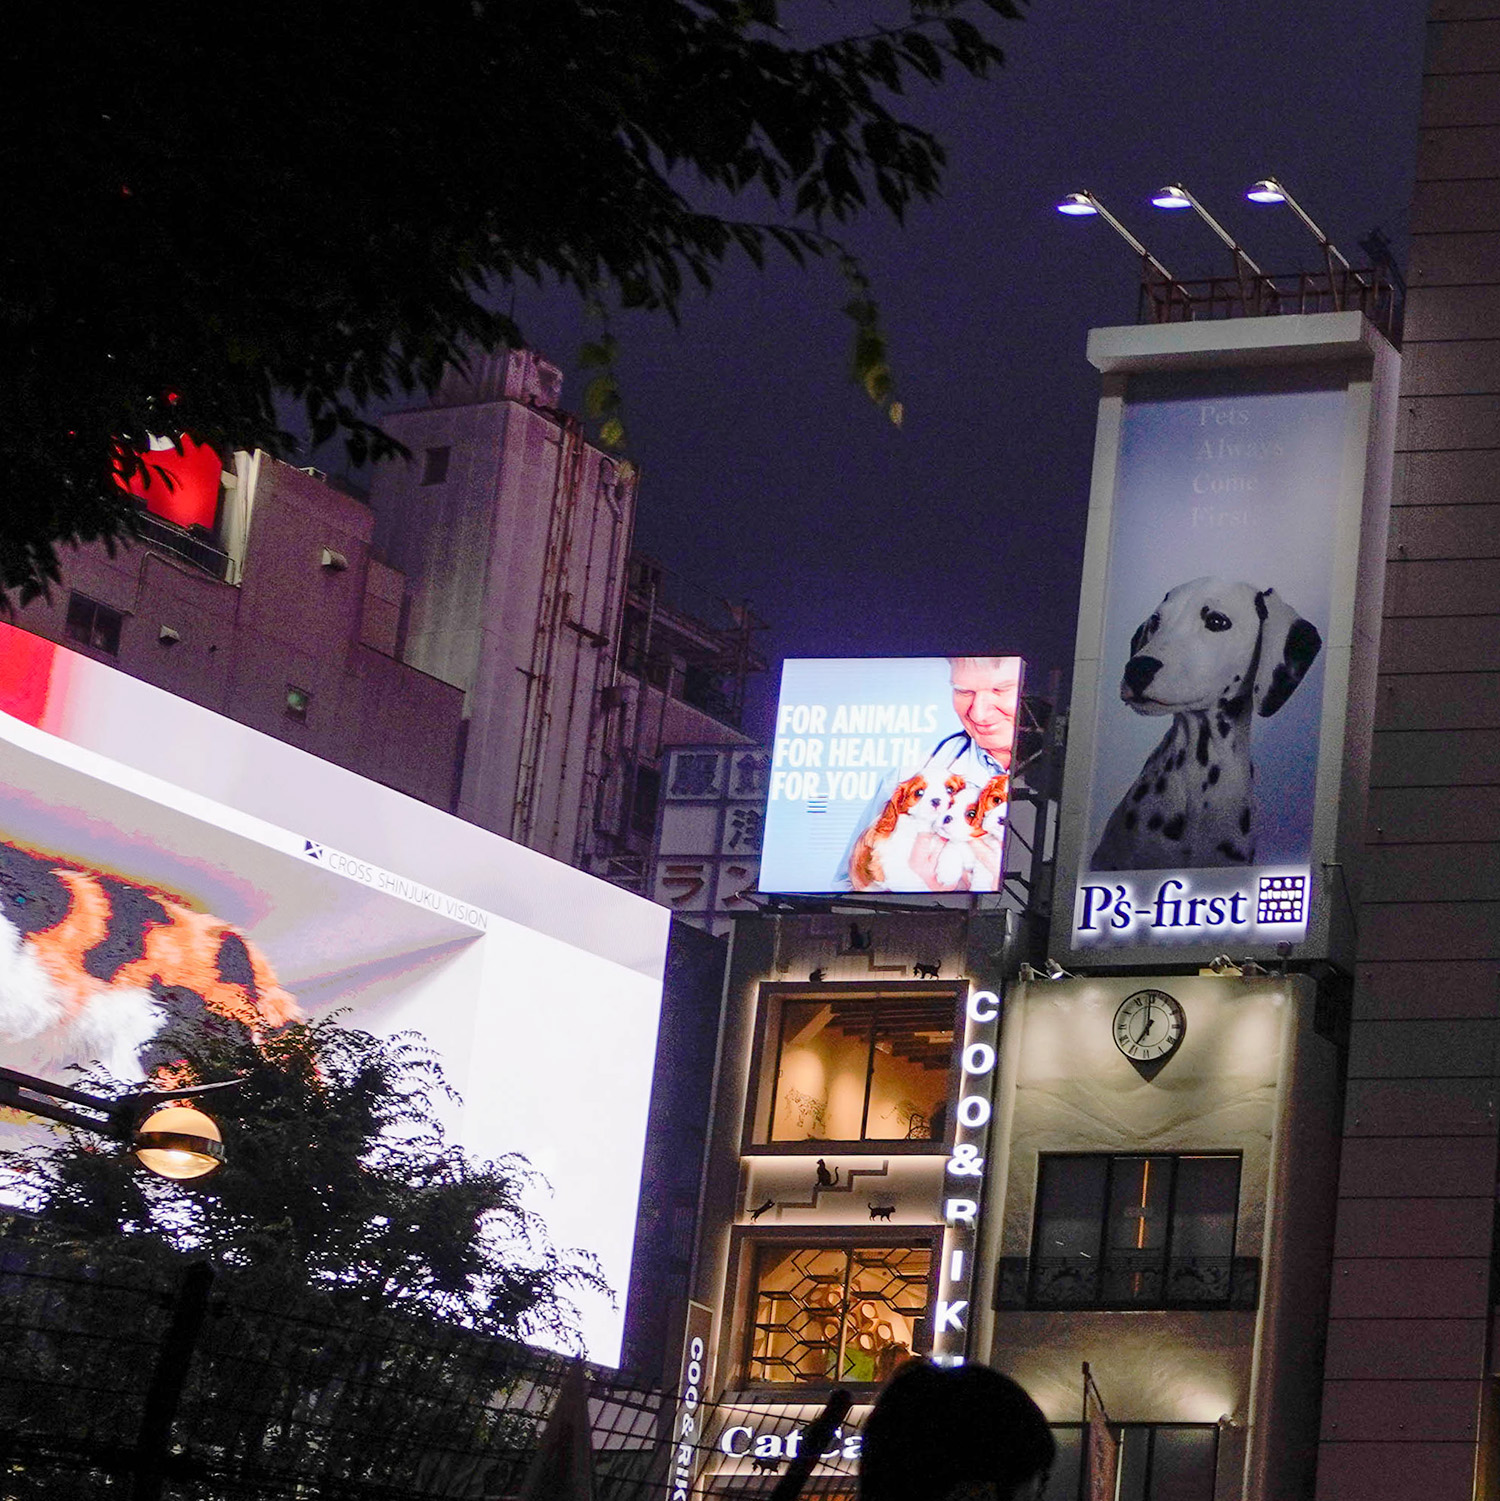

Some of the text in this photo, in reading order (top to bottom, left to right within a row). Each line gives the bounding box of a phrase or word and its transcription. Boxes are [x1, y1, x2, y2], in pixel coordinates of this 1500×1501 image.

[778, 704, 938, 734] FOR ANIMALS
[775, 737, 920, 767] FOR HEALTH
[771, 771, 822, 800] FOR
[826, 771, 877, 800] YOU
[329, 853, 488, 929] CROSS SHINJUKU VISION
[934, 990, 1000, 1368] COO&RIK
[720, 1426, 803, 1459] Cat
